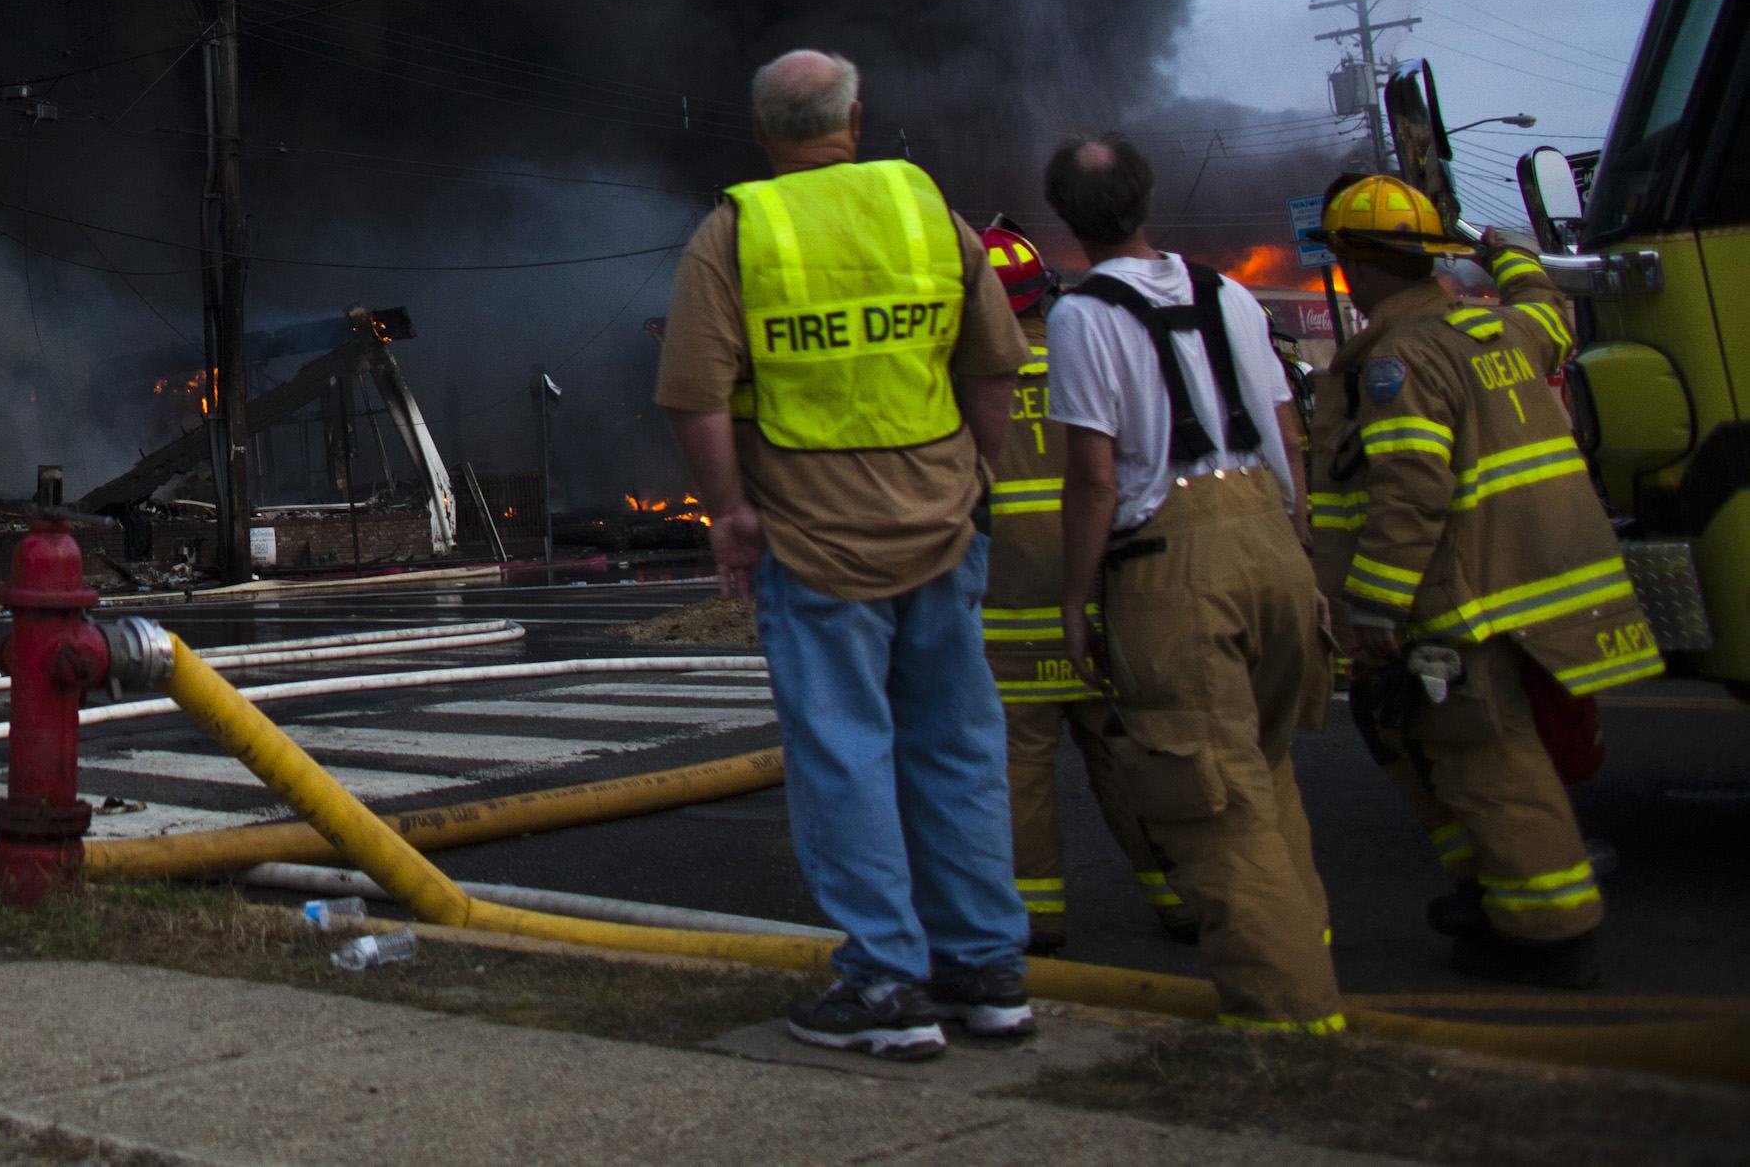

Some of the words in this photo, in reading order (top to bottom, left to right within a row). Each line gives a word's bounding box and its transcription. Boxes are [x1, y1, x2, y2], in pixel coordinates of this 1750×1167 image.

[763, 311, 850, 353] FIRE
[863, 302, 948, 343] DEPT.
[1471, 346, 1535, 392] OCEAN
[1507, 388, 1527, 424] 1
[1032, 422, 1045, 454] 1
